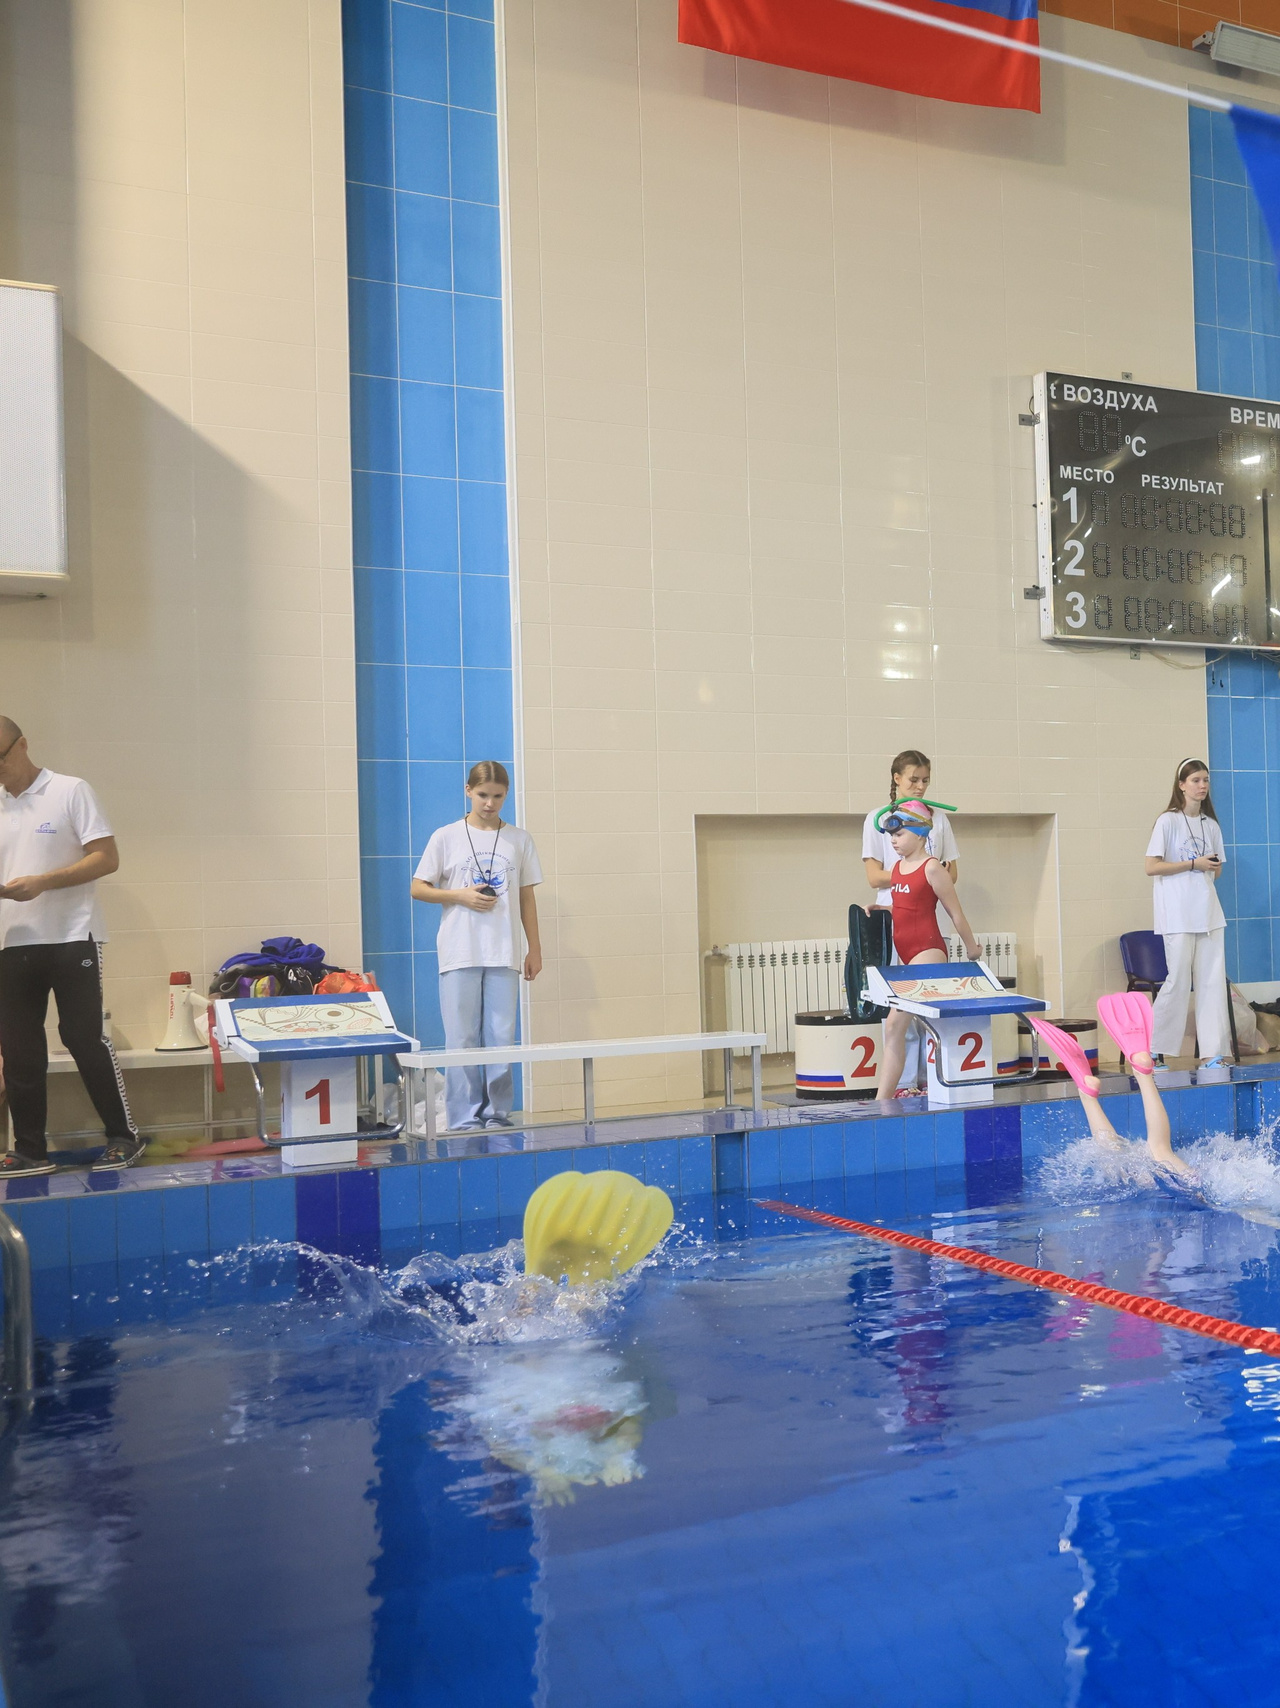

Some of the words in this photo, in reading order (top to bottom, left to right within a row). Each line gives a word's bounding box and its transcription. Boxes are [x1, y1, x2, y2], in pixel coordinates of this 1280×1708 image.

[1049, 382, 1057, 400] t
[1063, 383, 1159, 413] ВОЗДУХА
[1059, 464, 1115, 484] МЕСТО
[1141, 474, 1225, 496] РЕЗУЛЬТАТ
[1062, 486, 1079, 524] 1
[1063, 539, 1086, 577] 2
[1065, 591, 1087, 628] 3
[850, 1036, 878, 1078] 2
[927, 1038, 937, 1064] 2
[957, 1031, 986, 1072] 2
[305, 1078, 331, 1125] 1
